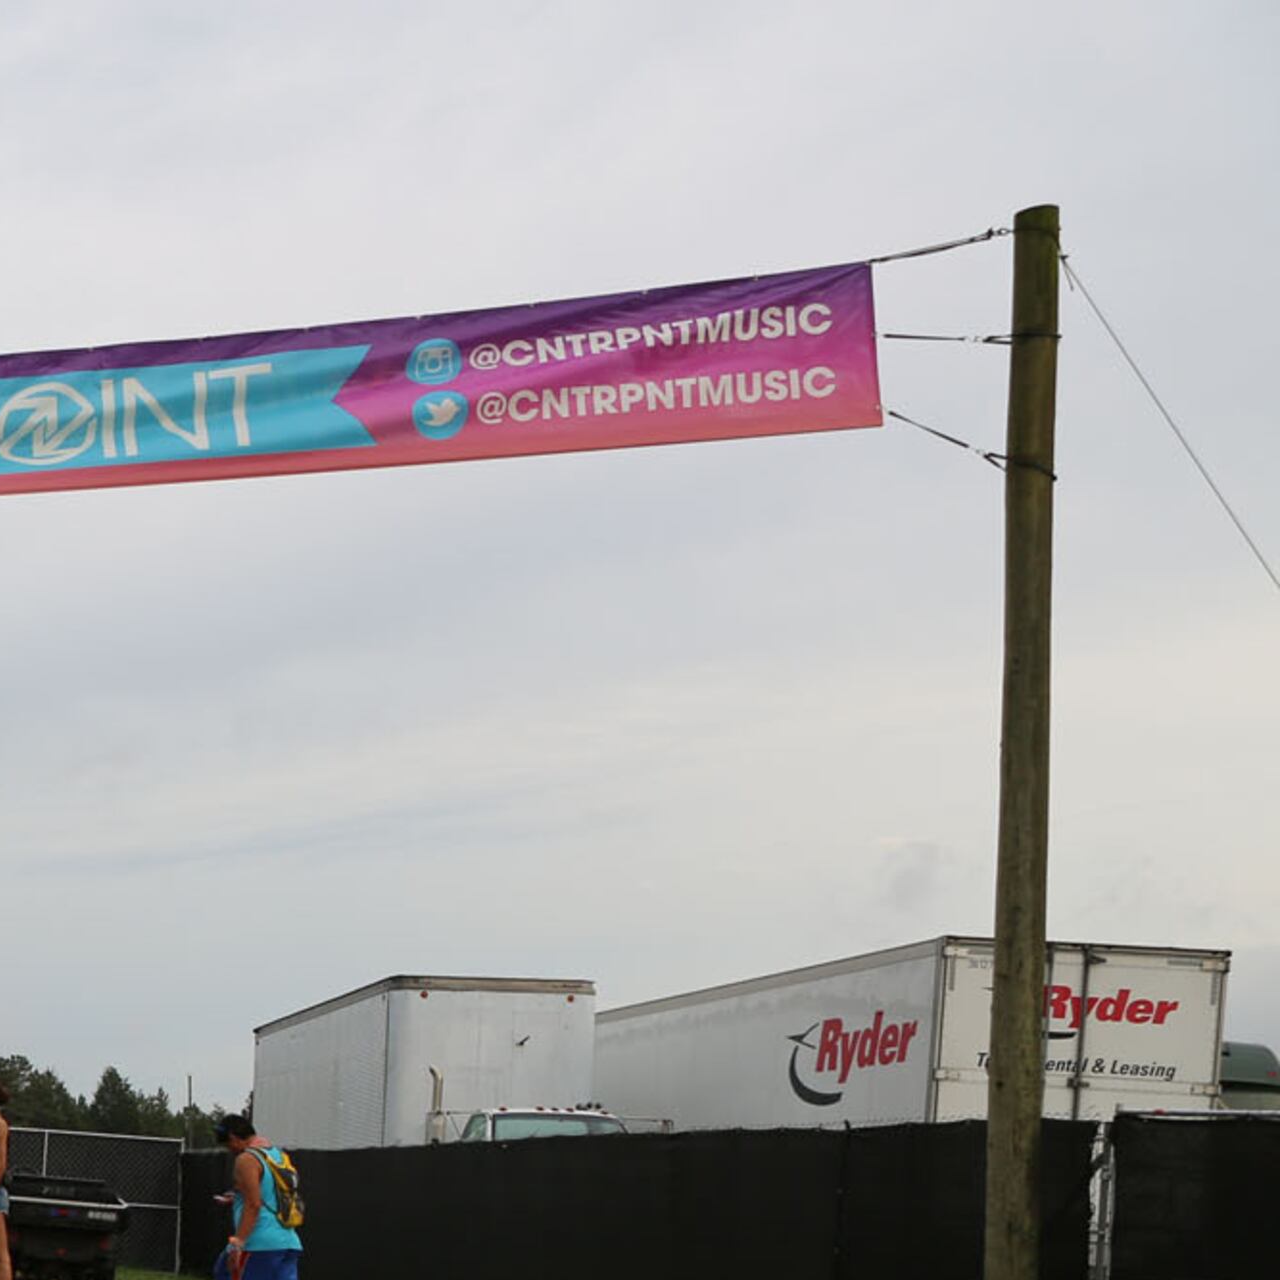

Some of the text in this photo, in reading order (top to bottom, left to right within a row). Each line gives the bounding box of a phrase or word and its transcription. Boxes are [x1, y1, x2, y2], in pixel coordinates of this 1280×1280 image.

[469, 303, 833, 371] @CNTRPNTMUSIC
[476, 366, 837, 424] @CNTRPNTMUSIC
[1041, 984, 1179, 1029] Ryder
[815, 1009, 918, 1084] Ryder
[1091, 1058, 1105, 1074] &
[1110, 1059, 1177, 1083] Leasing
